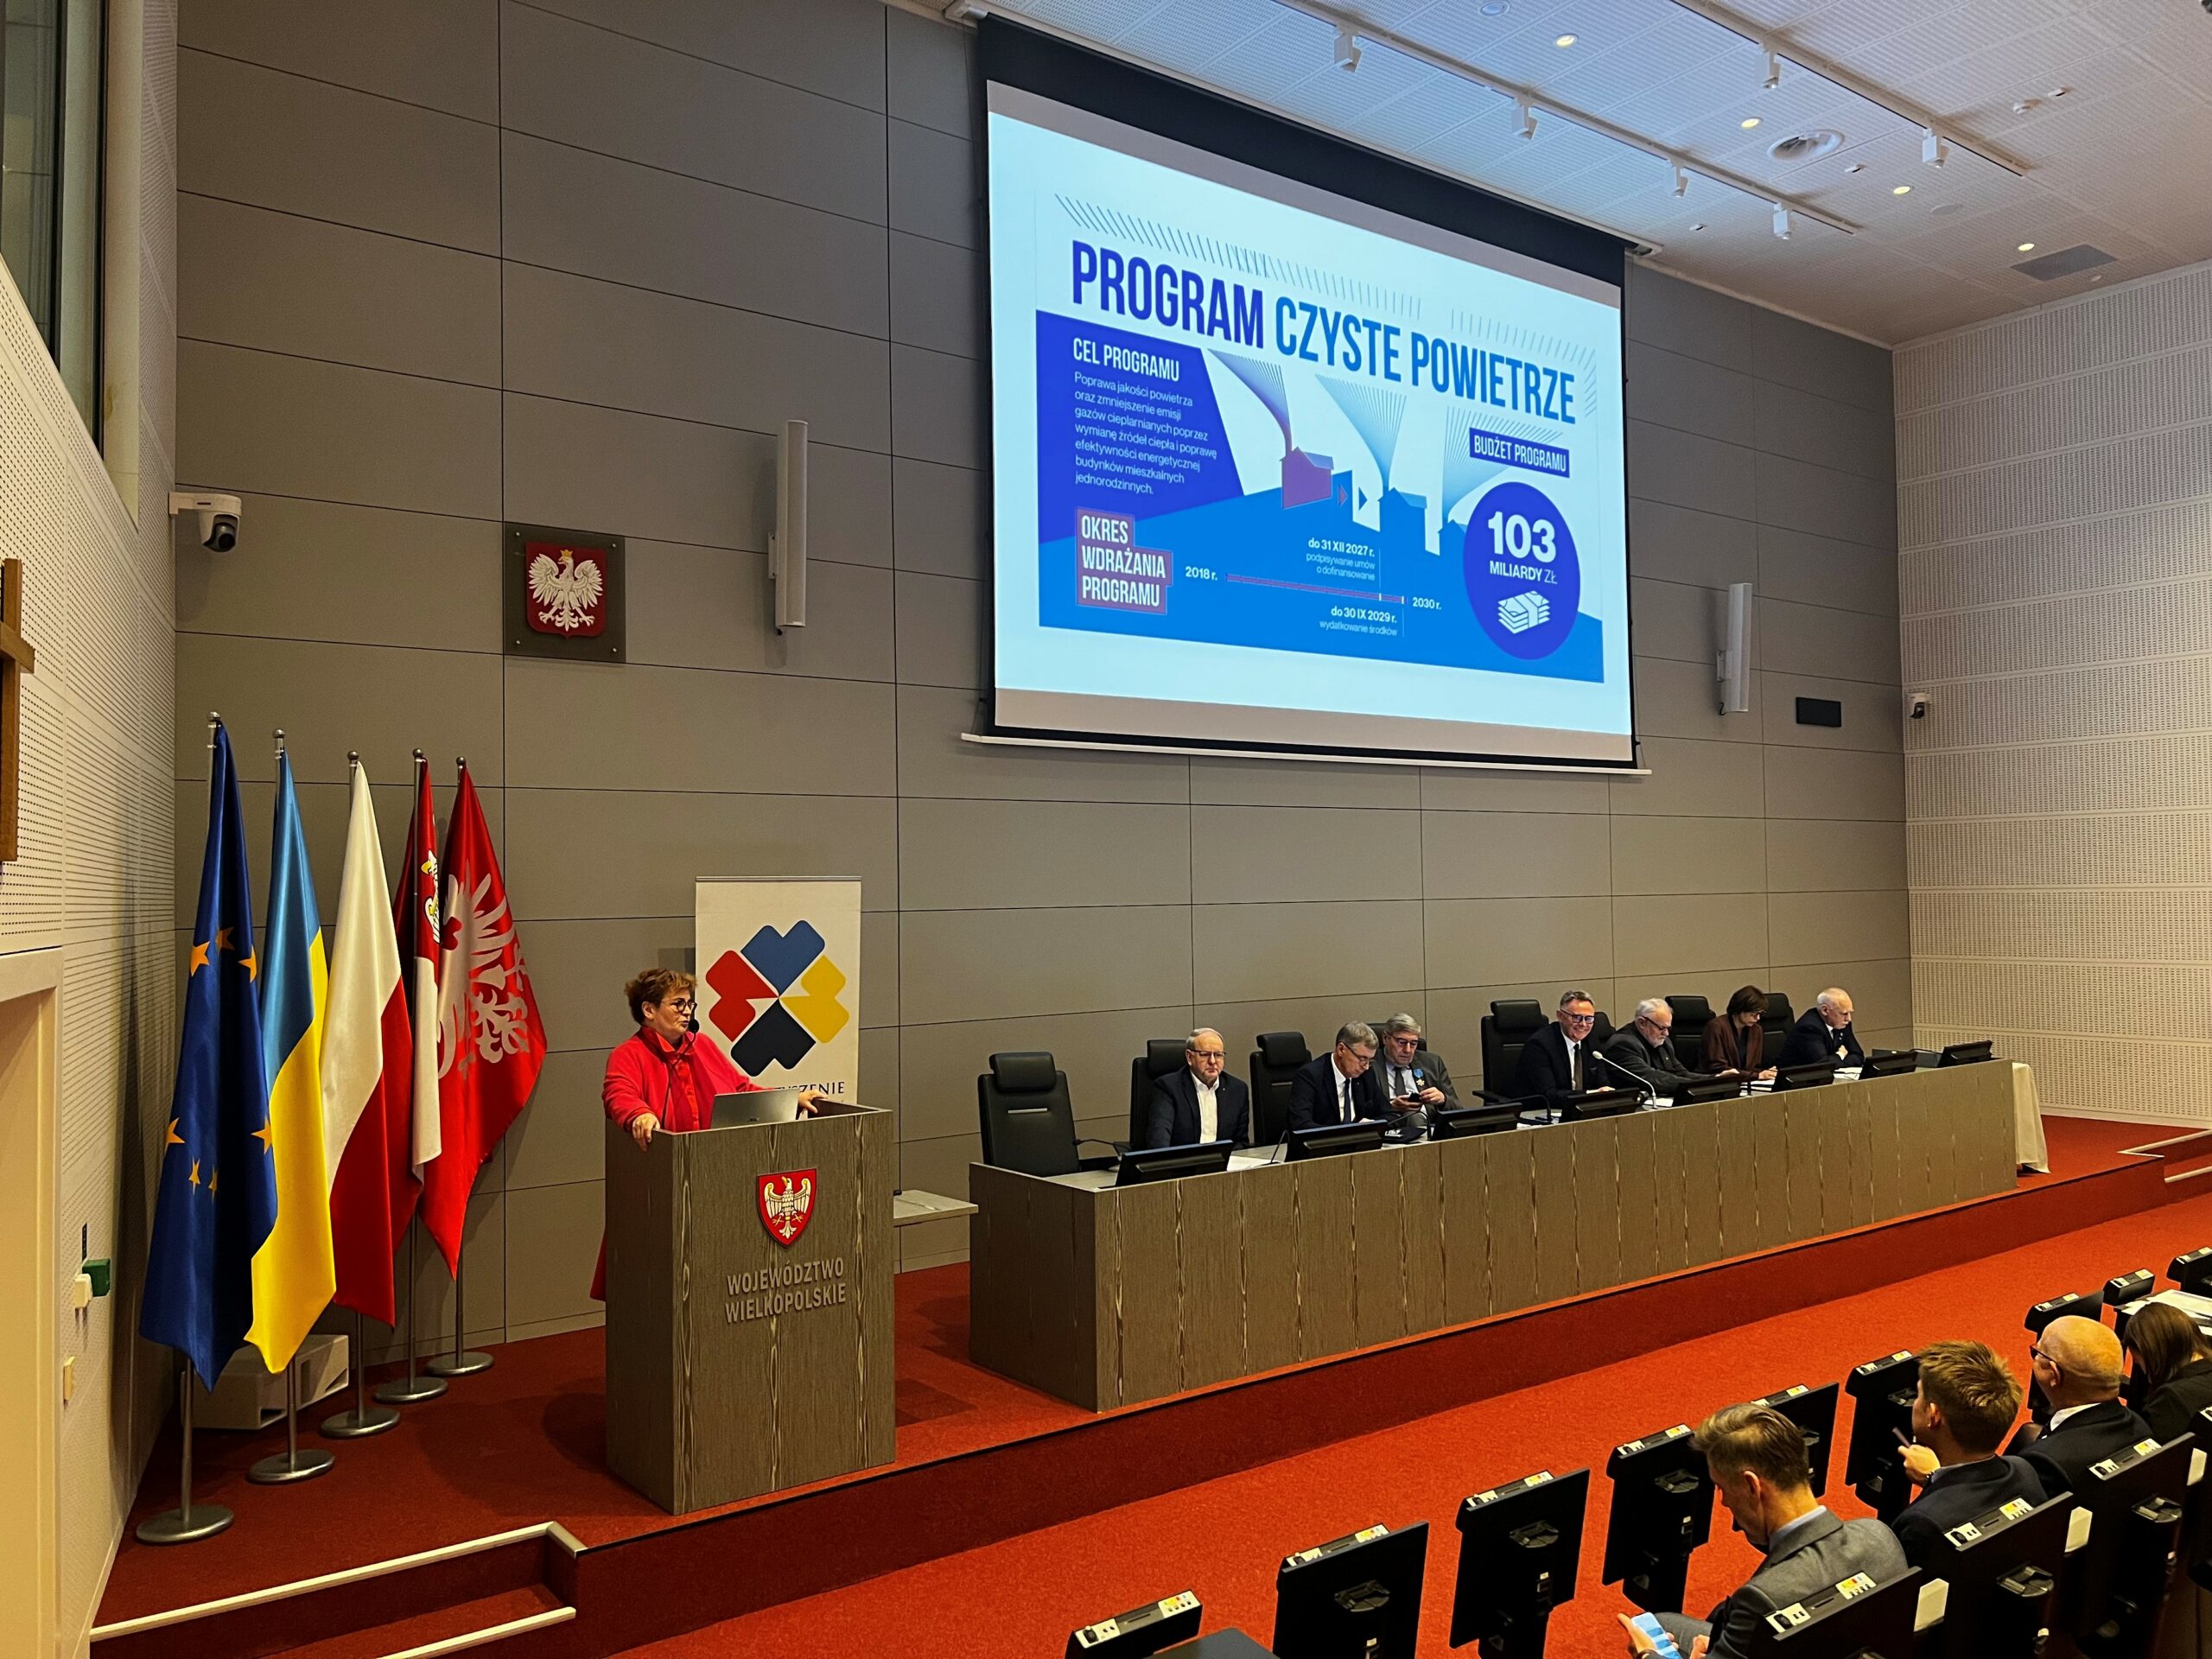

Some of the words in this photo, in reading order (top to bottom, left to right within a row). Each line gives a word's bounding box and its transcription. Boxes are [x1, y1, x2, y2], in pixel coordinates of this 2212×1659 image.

[1072, 240, 1264, 349] PROGRAM
[1275, 296, 1402, 383] CZYSTE
[1411, 331, 1576, 424] POWIETRZE
[1073, 337, 1100, 365] CEL
[1103, 344, 1179, 382] PROGRAMU
[1075, 372, 1116, 391] Poprawa
[1117, 380, 1148, 398] jakości
[1150, 390, 1193, 407] powietrza
[1075, 391, 1096, 404] oraz
[1097, 394, 1155, 415] zmniejszenie
[1156, 407, 1181, 423] emisji
[1074, 407, 1106, 422] gazów
[1107, 413, 1173, 435] cieplarnianych
[1173, 426, 1209, 442] poprzez
[1075, 423, 1117, 442] wymianę
[1118, 431, 1147, 445] źródeł
[1148, 435, 1175, 451] ciepła
[1179, 442, 1217, 460] poprawę
[1075, 439, 1137, 461] efektywności
[1138, 451, 1201, 473] energetycznej
[1474, 435, 1512, 461] BUDŻET
[1515, 444, 1567, 472] PROGRAMU
[1075, 471, 1154, 494] jednorodzinnych.
[1076, 454, 1124, 473] budynków
[1125, 465, 1185, 484] mieszkalnych
[1082, 515, 1128, 544] OKRES
[1488, 511, 1556, 563] 103
[1082, 545, 1166, 579] WDRAŻANIA
[1306, 553, 1353, 567] podpisywanie
[1355, 559, 1376, 570] umów
[1308, 537, 1320, 549] do
[1321, 539, 1332, 551] 31
[1332, 540, 1344, 553] XII
[1345, 543, 1369, 556] 2027
[1370, 549, 1375, 557] r.
[1185, 566, 1210, 580] 2018
[1211, 572, 1217, 581] r.
[1323, 565, 1376, 582] dofinansowanie
[1490, 561, 1542, 582] MILIARDY
[1544, 569, 1558, 584] ZŁ
[1082, 575, 1160, 607] PROGRAMU
[1413, 597, 1435, 609] 2030
[1436, 601, 1442, 610] r.
[1319, 620, 1369, 633] wydatkowanie
[1369, 625, 1398, 637] środków
[1331, 606, 1343, 617] do
[1344, 607, 1356, 619] 30
[1357, 608, 1366, 620] IX
[1368, 610, 1390, 622] 2029
[728, 1257, 844, 1297] WOJEWÓDZTWO
[725, 1282, 847, 1324] WIELKOPOLSKIE
